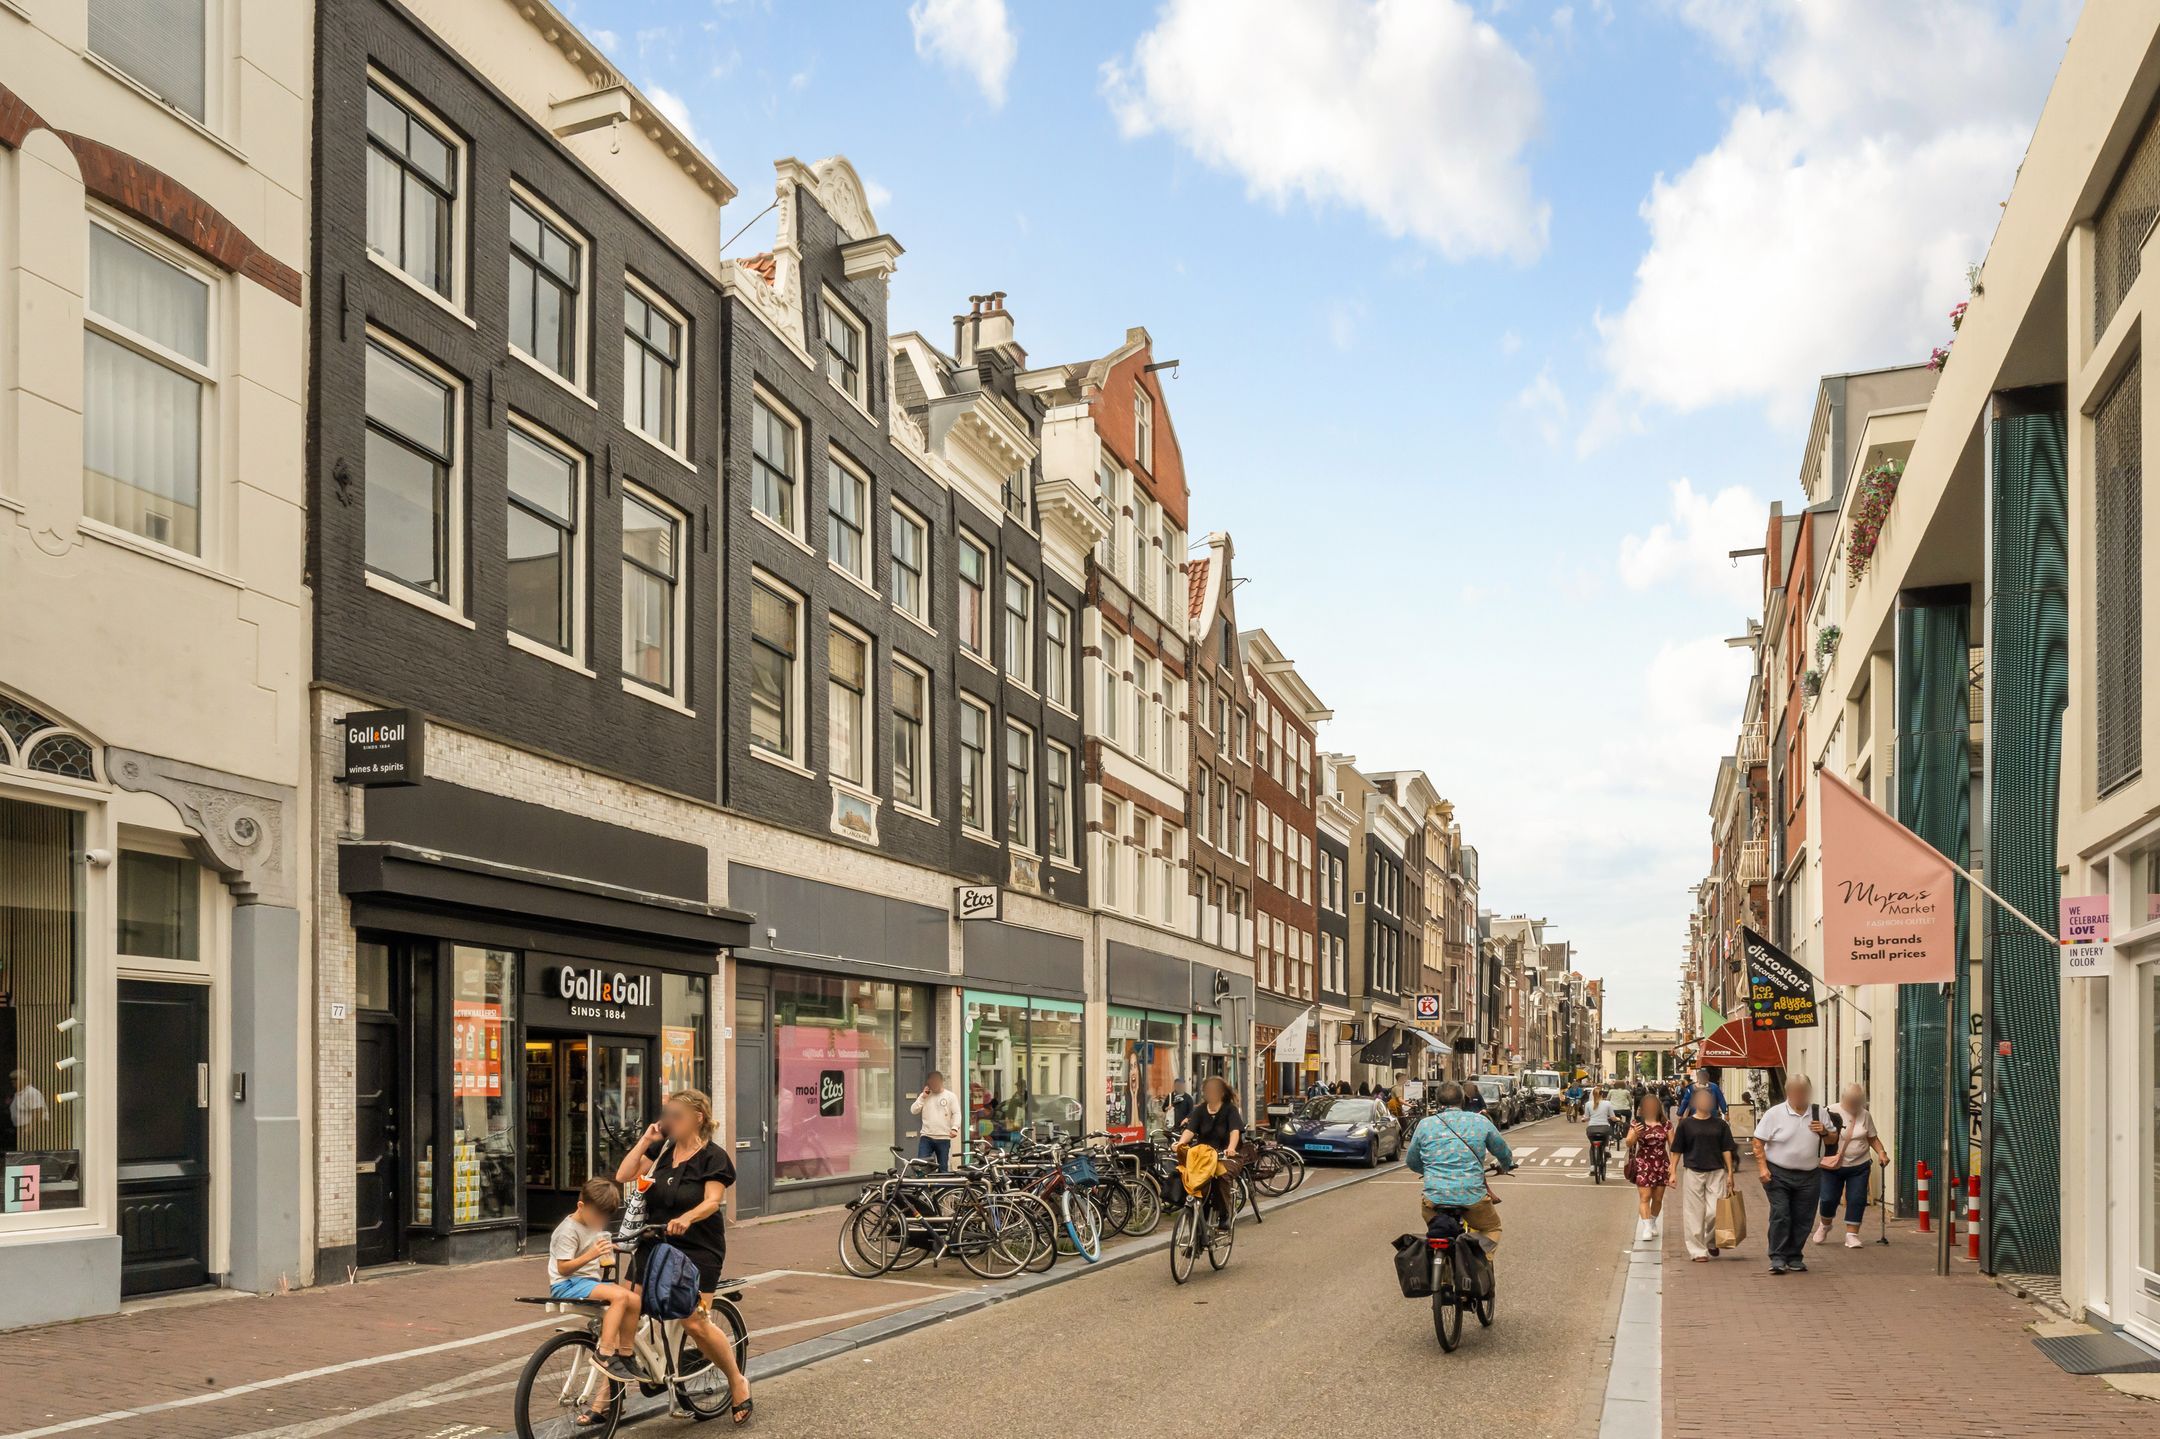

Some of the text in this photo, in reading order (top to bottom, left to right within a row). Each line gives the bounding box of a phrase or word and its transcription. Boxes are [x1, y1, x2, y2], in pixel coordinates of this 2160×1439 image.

[349, 724, 405, 743] Gall&Gall
[349, 762, 404, 774] wines & spirits
[963, 890, 994, 908] Etos
[1888, 903, 1936, 915] Market
[2069, 906, 2081, 915] WE
[1867, 917, 1936, 928] FASHION OUTLET
[2069, 914, 2109, 926] CELEBRATE
[2070, 925, 2095, 935] LOVE
[1853, 934, 1922, 948] big brands
[1850, 949, 1927, 961] Small prices
[2069, 947, 2104, 957] IN EVERY
[1747, 944, 1811, 992] discostars
[2069, 958, 2095, 967] COLOR
[1751, 962, 1789, 991] recordstore
[560, 965, 651, 1007] Gall&Gall
[1752, 985, 1772, 994] Pop
[1752, 991, 1774, 1000] Jazz
[1780, 996, 1806, 1004] Blues
[333, 1005, 344, 1016] 77
[1420, 1001, 1434, 1012] K
[1773, 1001, 1813, 1011] Reggae
[571, 1006, 626, 1019] SINDS 1884
[1784, 1012, 1814, 1020] Classical
[795, 1082, 818, 1096] mooi
[821, 1076, 844, 1101] Etos
[807, 1097, 818, 1105] van
[10, 1174, 35, 1203] E
